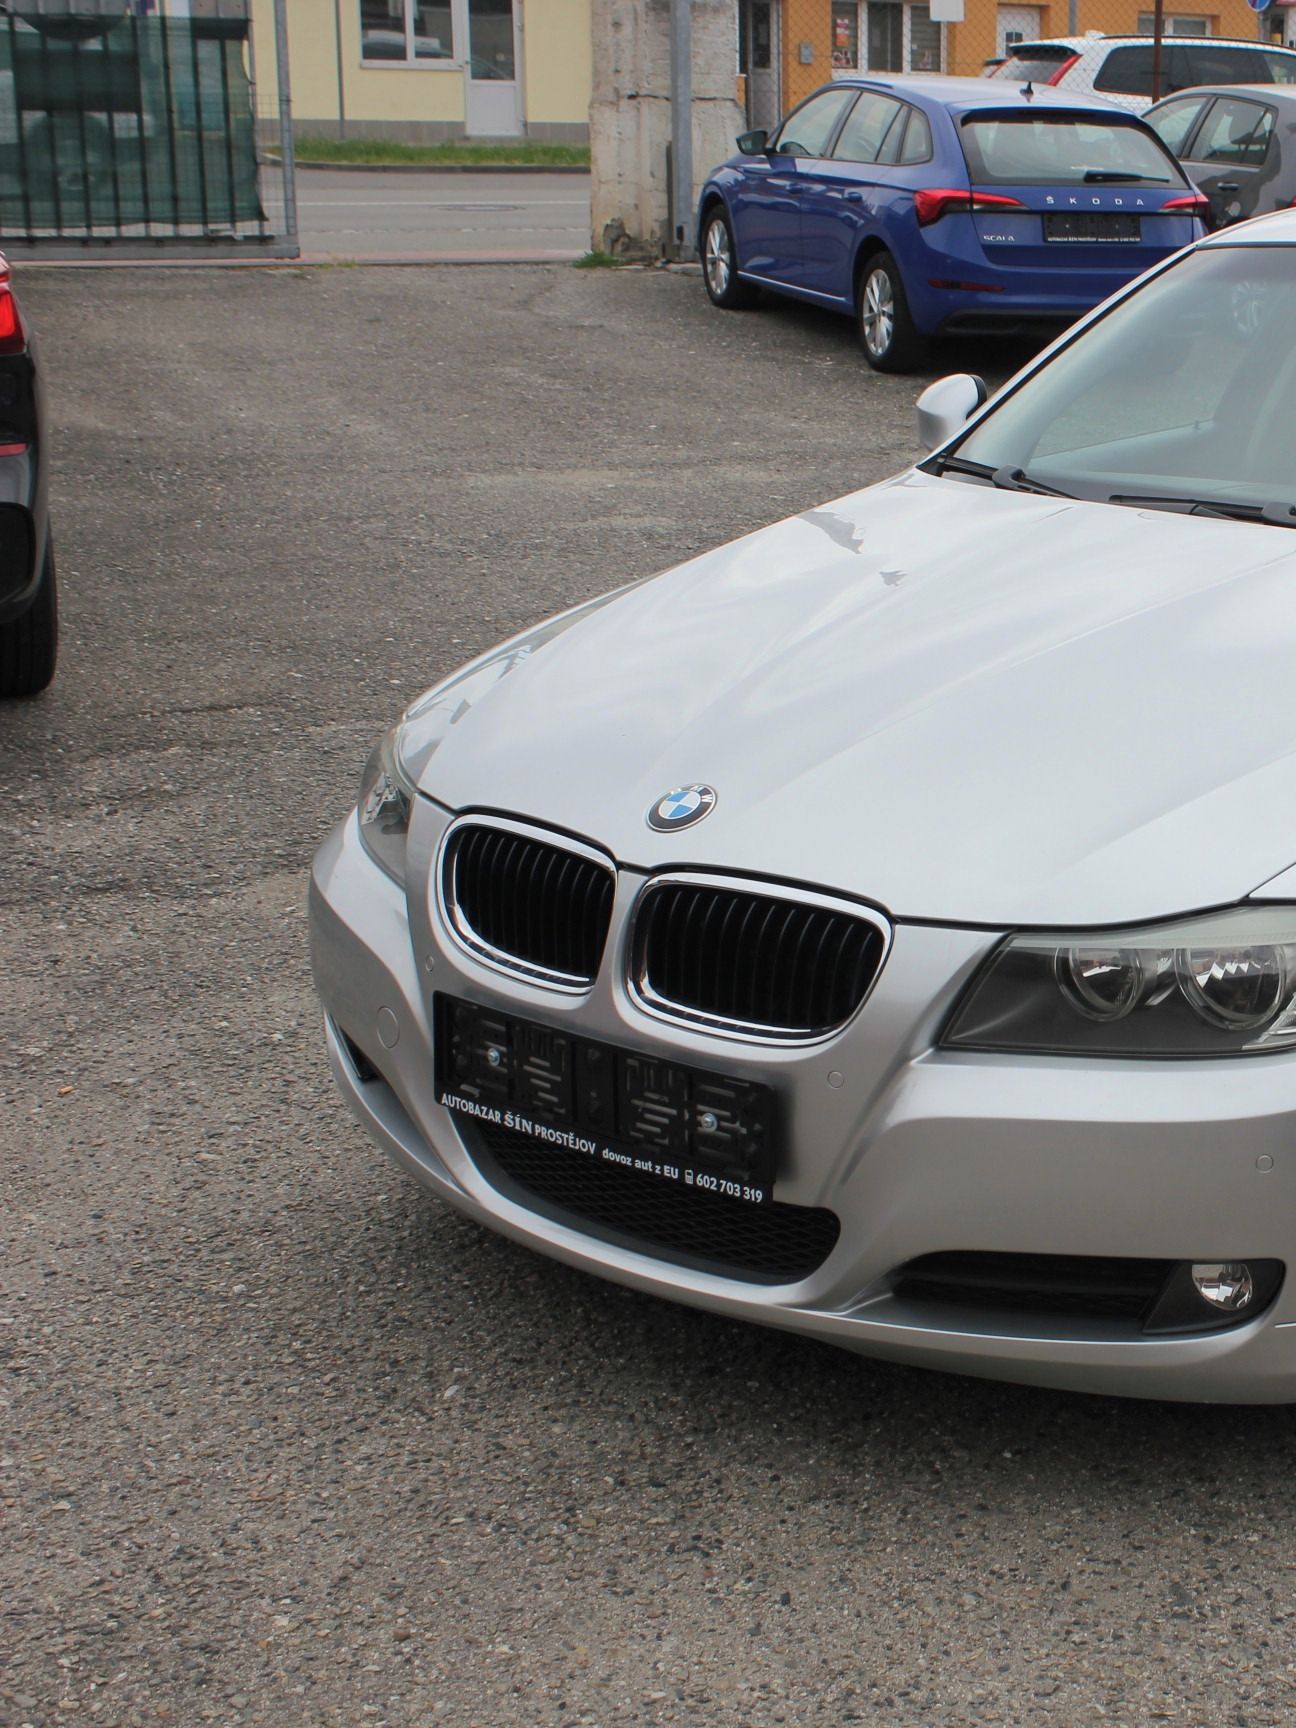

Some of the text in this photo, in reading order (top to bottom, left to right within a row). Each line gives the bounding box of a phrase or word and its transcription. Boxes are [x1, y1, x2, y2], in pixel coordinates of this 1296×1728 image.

[441, 1092, 763, 1203] AUTOBAZAR ŠÍN PROSTĚJOV dovoz aut z EU 602 703 319
